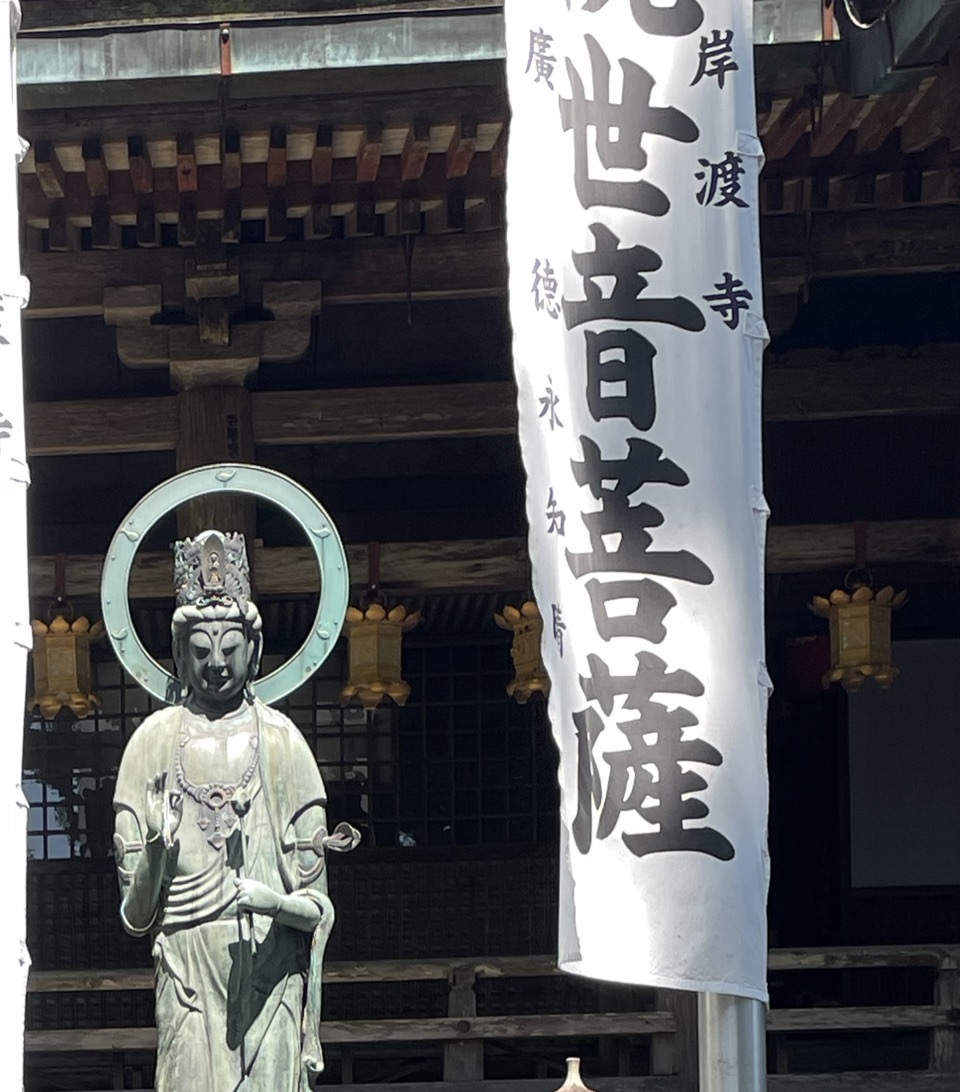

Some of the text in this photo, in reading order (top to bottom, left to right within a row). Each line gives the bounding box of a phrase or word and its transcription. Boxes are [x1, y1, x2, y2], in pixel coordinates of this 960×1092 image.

[559, 0, 735, 860] 世音菩薩
[689, 29, 753, 331] 岸渡寺
